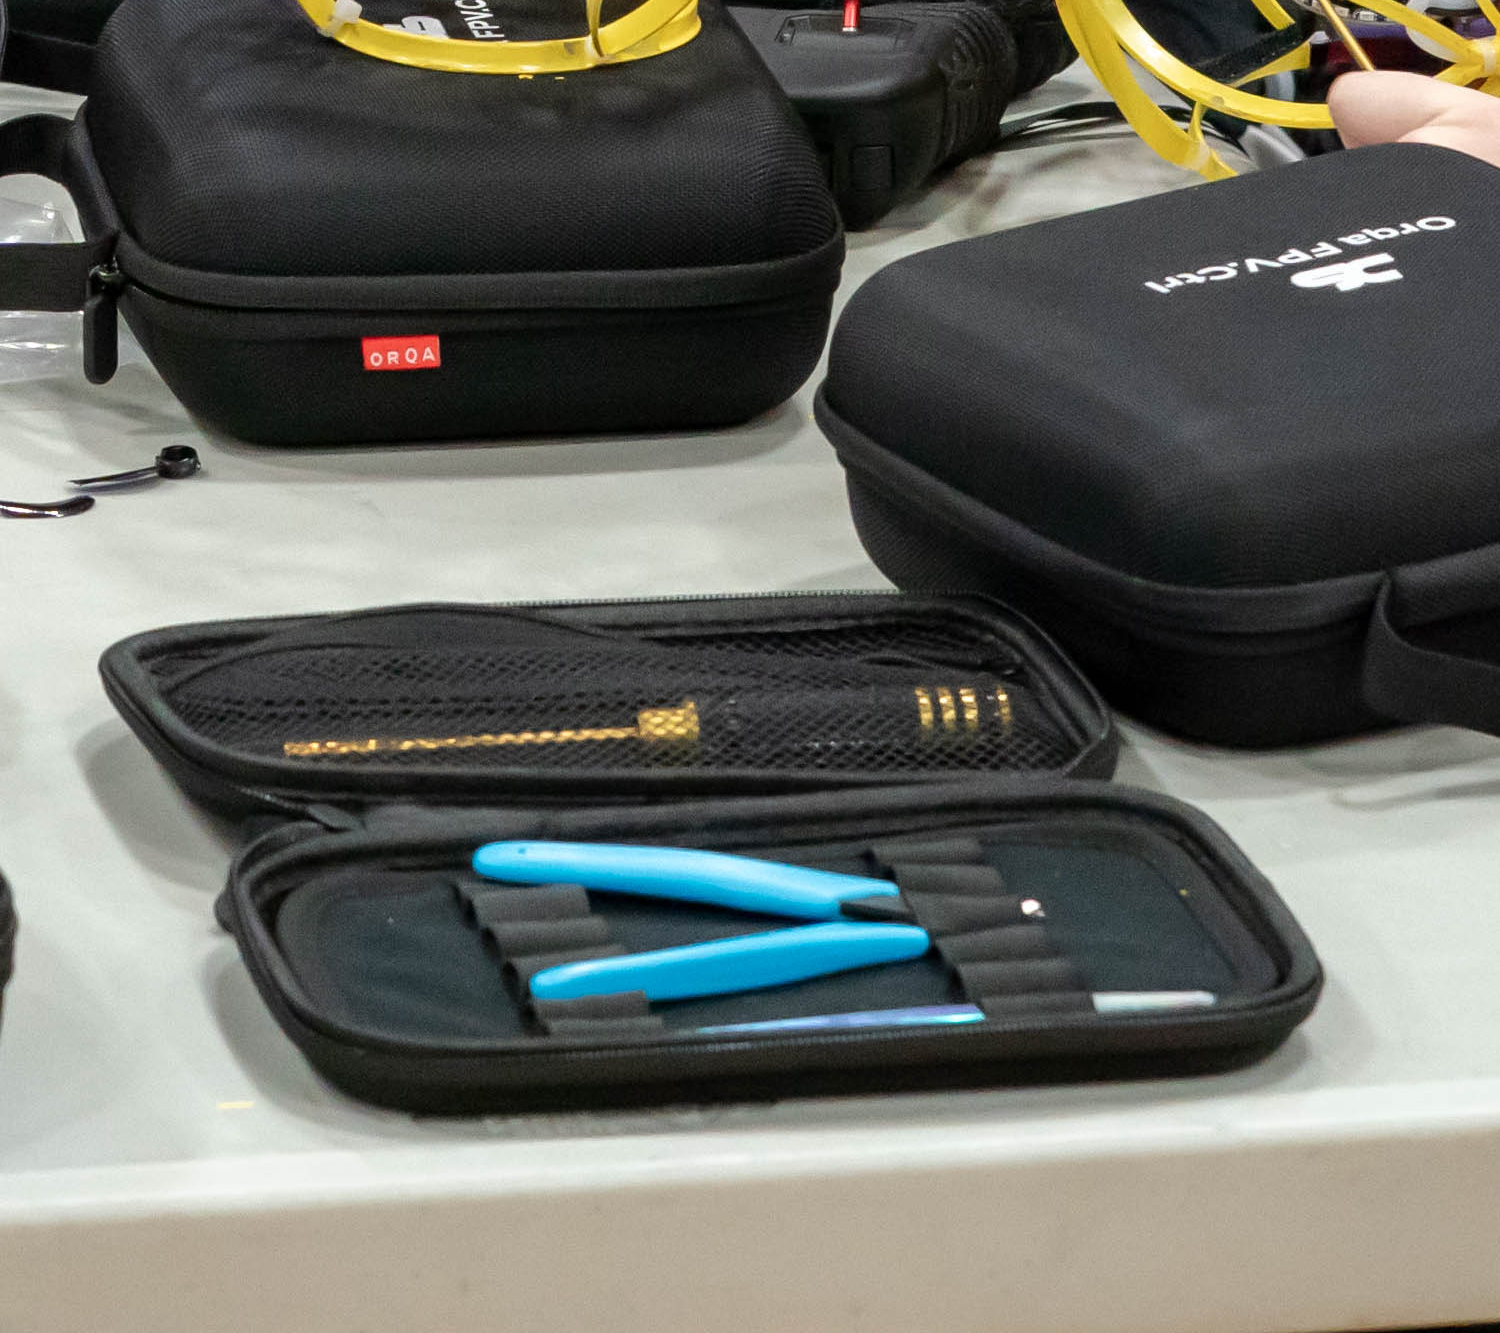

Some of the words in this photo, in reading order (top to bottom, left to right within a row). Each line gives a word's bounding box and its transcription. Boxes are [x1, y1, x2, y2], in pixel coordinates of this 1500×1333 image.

[1337, 215, 1457, 246] Orqa
[1144, 241, 1343, 294] FPV.Ctrl
[369, 346, 437, 367] ORQA
